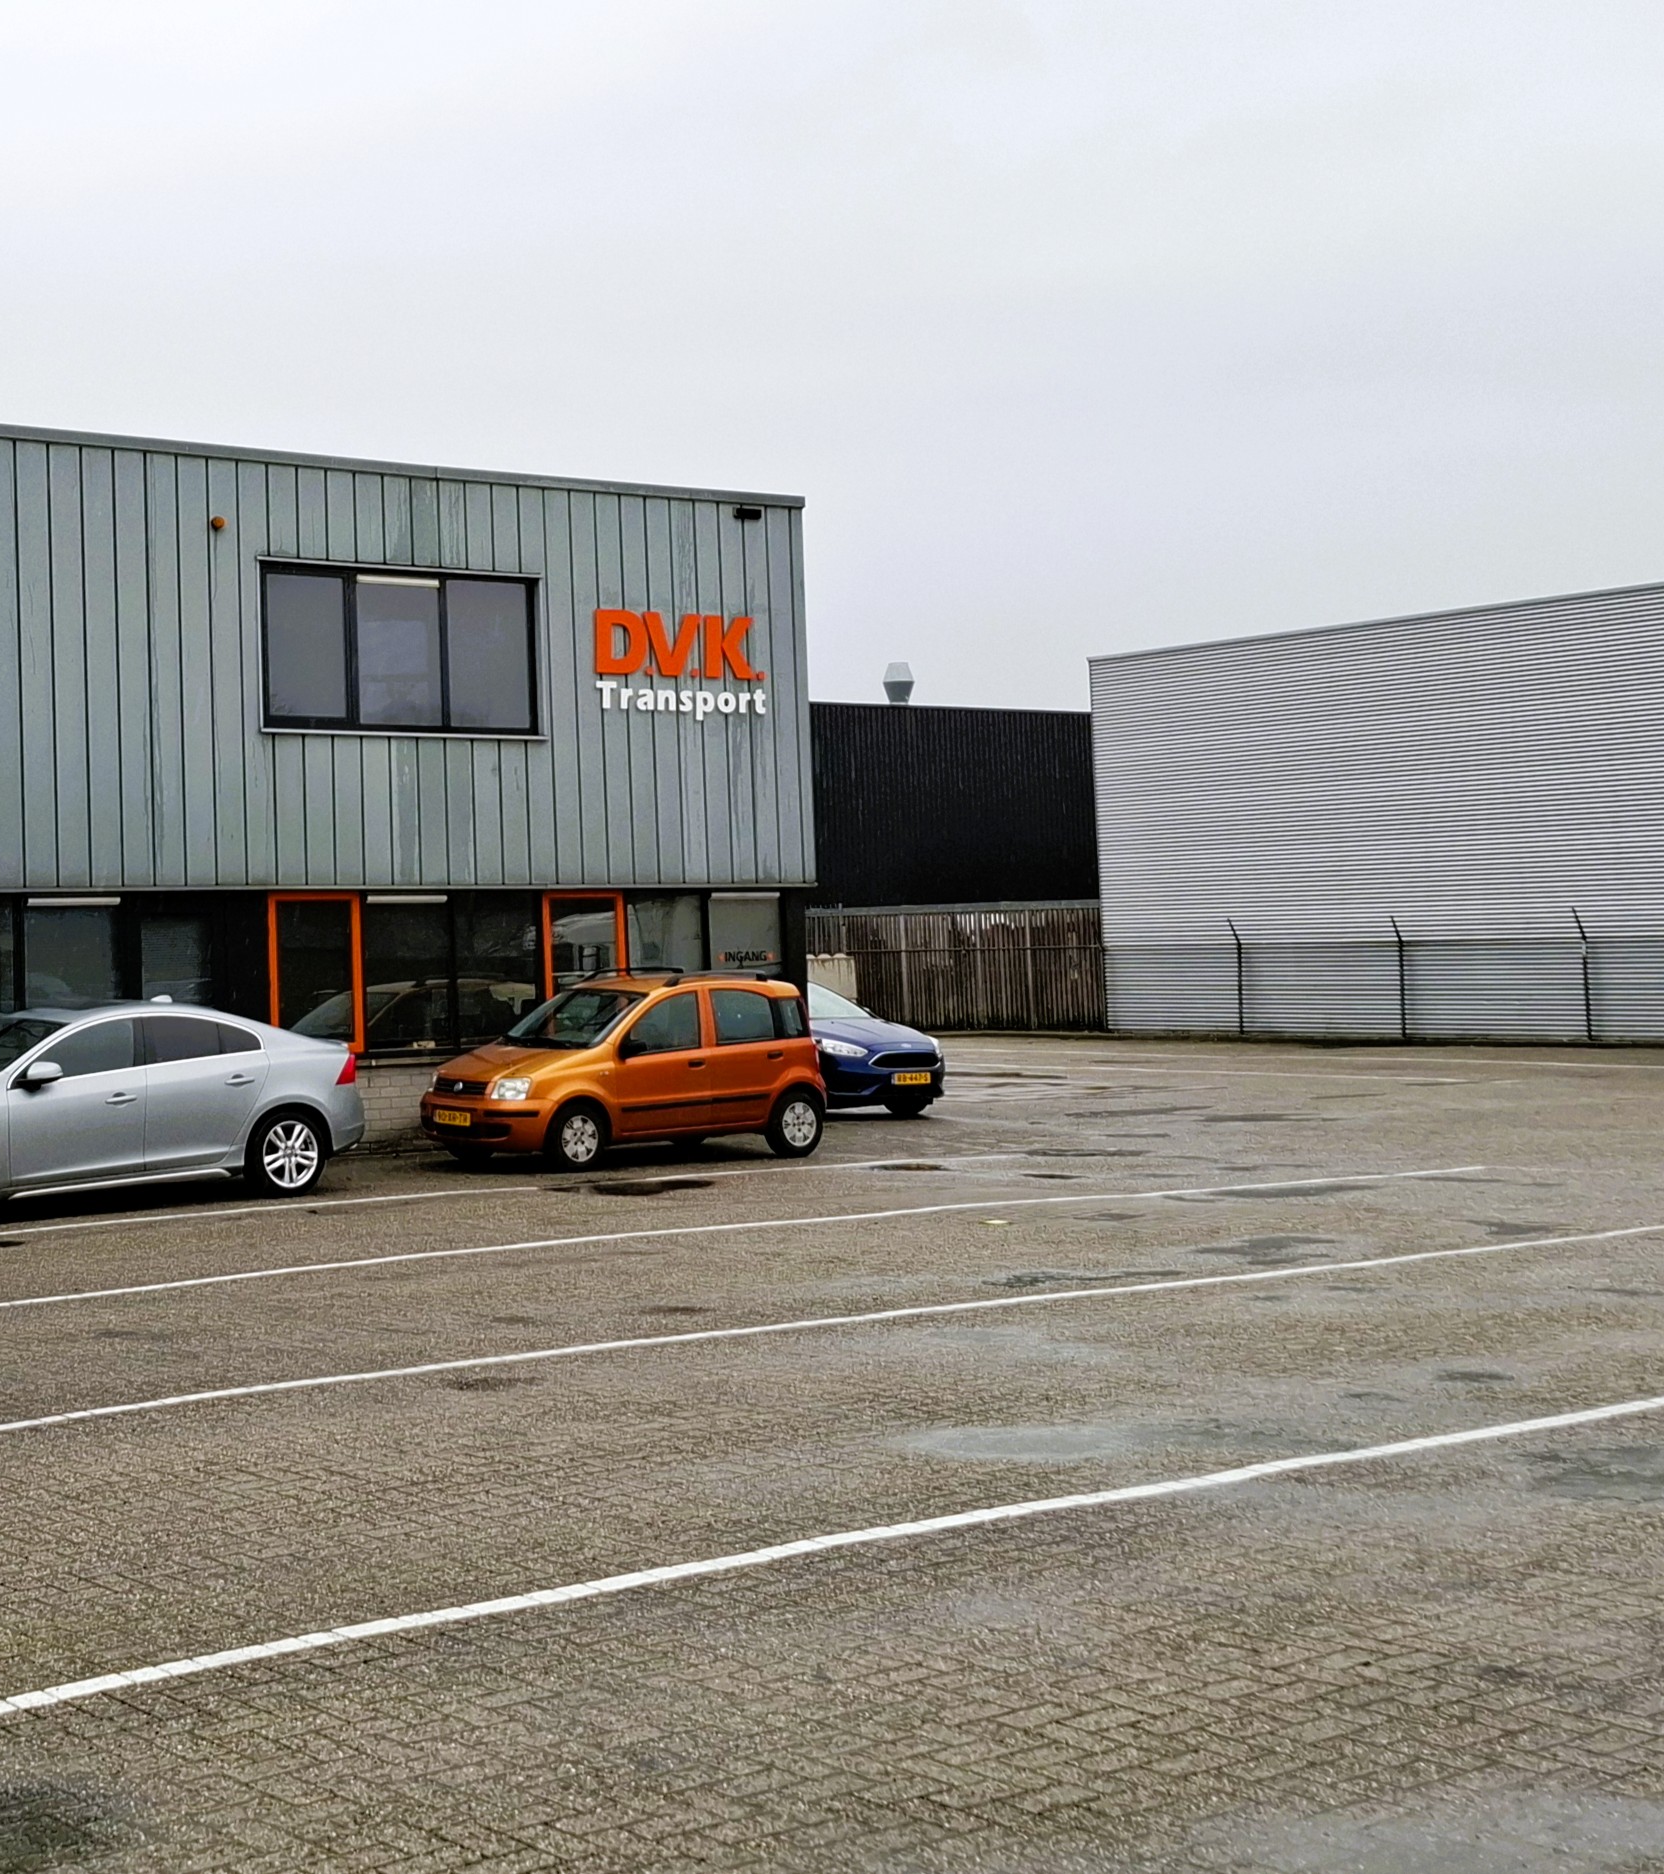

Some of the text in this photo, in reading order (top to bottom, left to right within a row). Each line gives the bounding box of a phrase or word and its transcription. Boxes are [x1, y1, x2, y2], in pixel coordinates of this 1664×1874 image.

[594, 608, 768, 681] D.V.K.
[595, 680, 767, 722] Transport
[724, 950, 767, 963] INGANG
